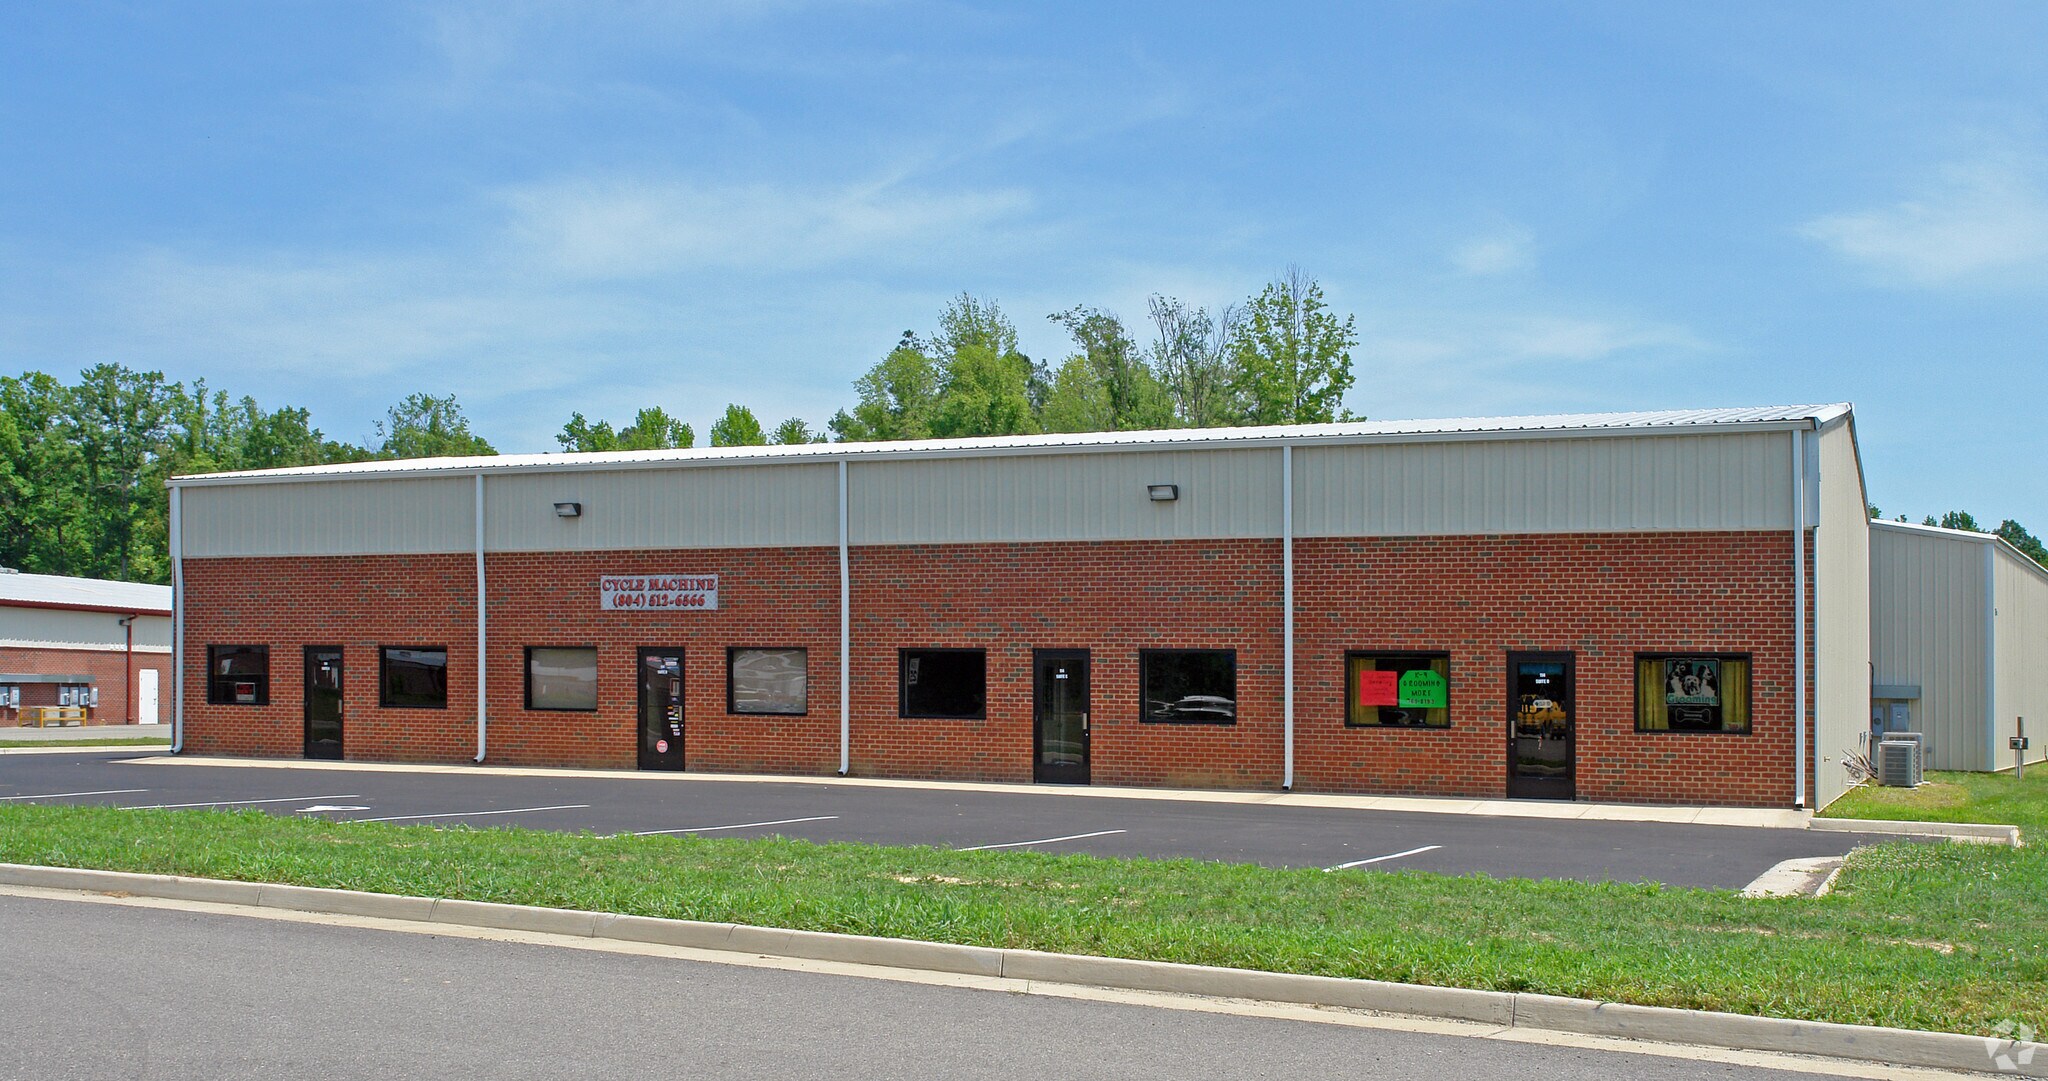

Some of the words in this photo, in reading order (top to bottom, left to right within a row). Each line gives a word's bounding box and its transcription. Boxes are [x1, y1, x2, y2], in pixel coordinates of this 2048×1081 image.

[602, 578, 646, 591] CYCLE
[648, 578, 716, 591] MACHINE
[612, 592, 647, 608] (804)
[1415, 671, 1428, 679] K-9
[1666, 694, 1718, 706] Grooming
